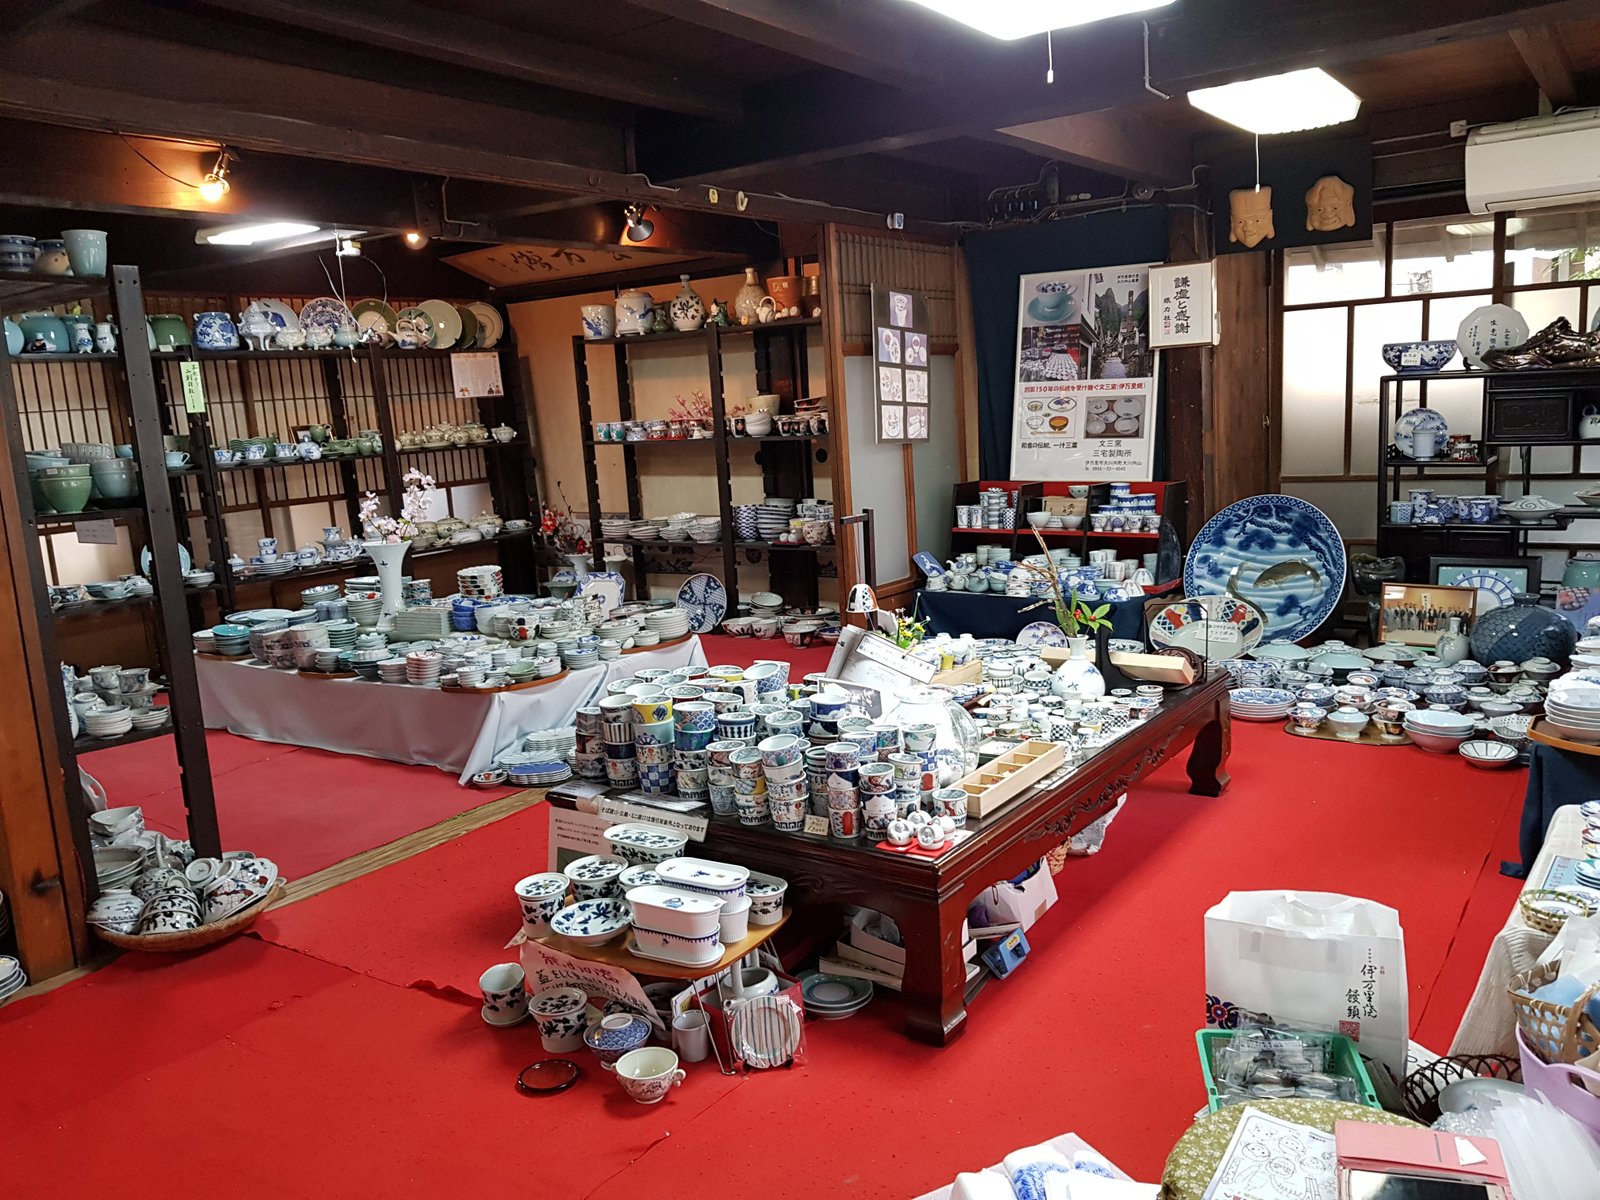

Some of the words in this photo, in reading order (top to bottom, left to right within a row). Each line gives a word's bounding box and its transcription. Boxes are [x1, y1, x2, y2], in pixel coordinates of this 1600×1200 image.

[1173, 276, 1191, 334] 謙虚と感謝
[1092, 449, 1132, 458] 三宅製陶所
